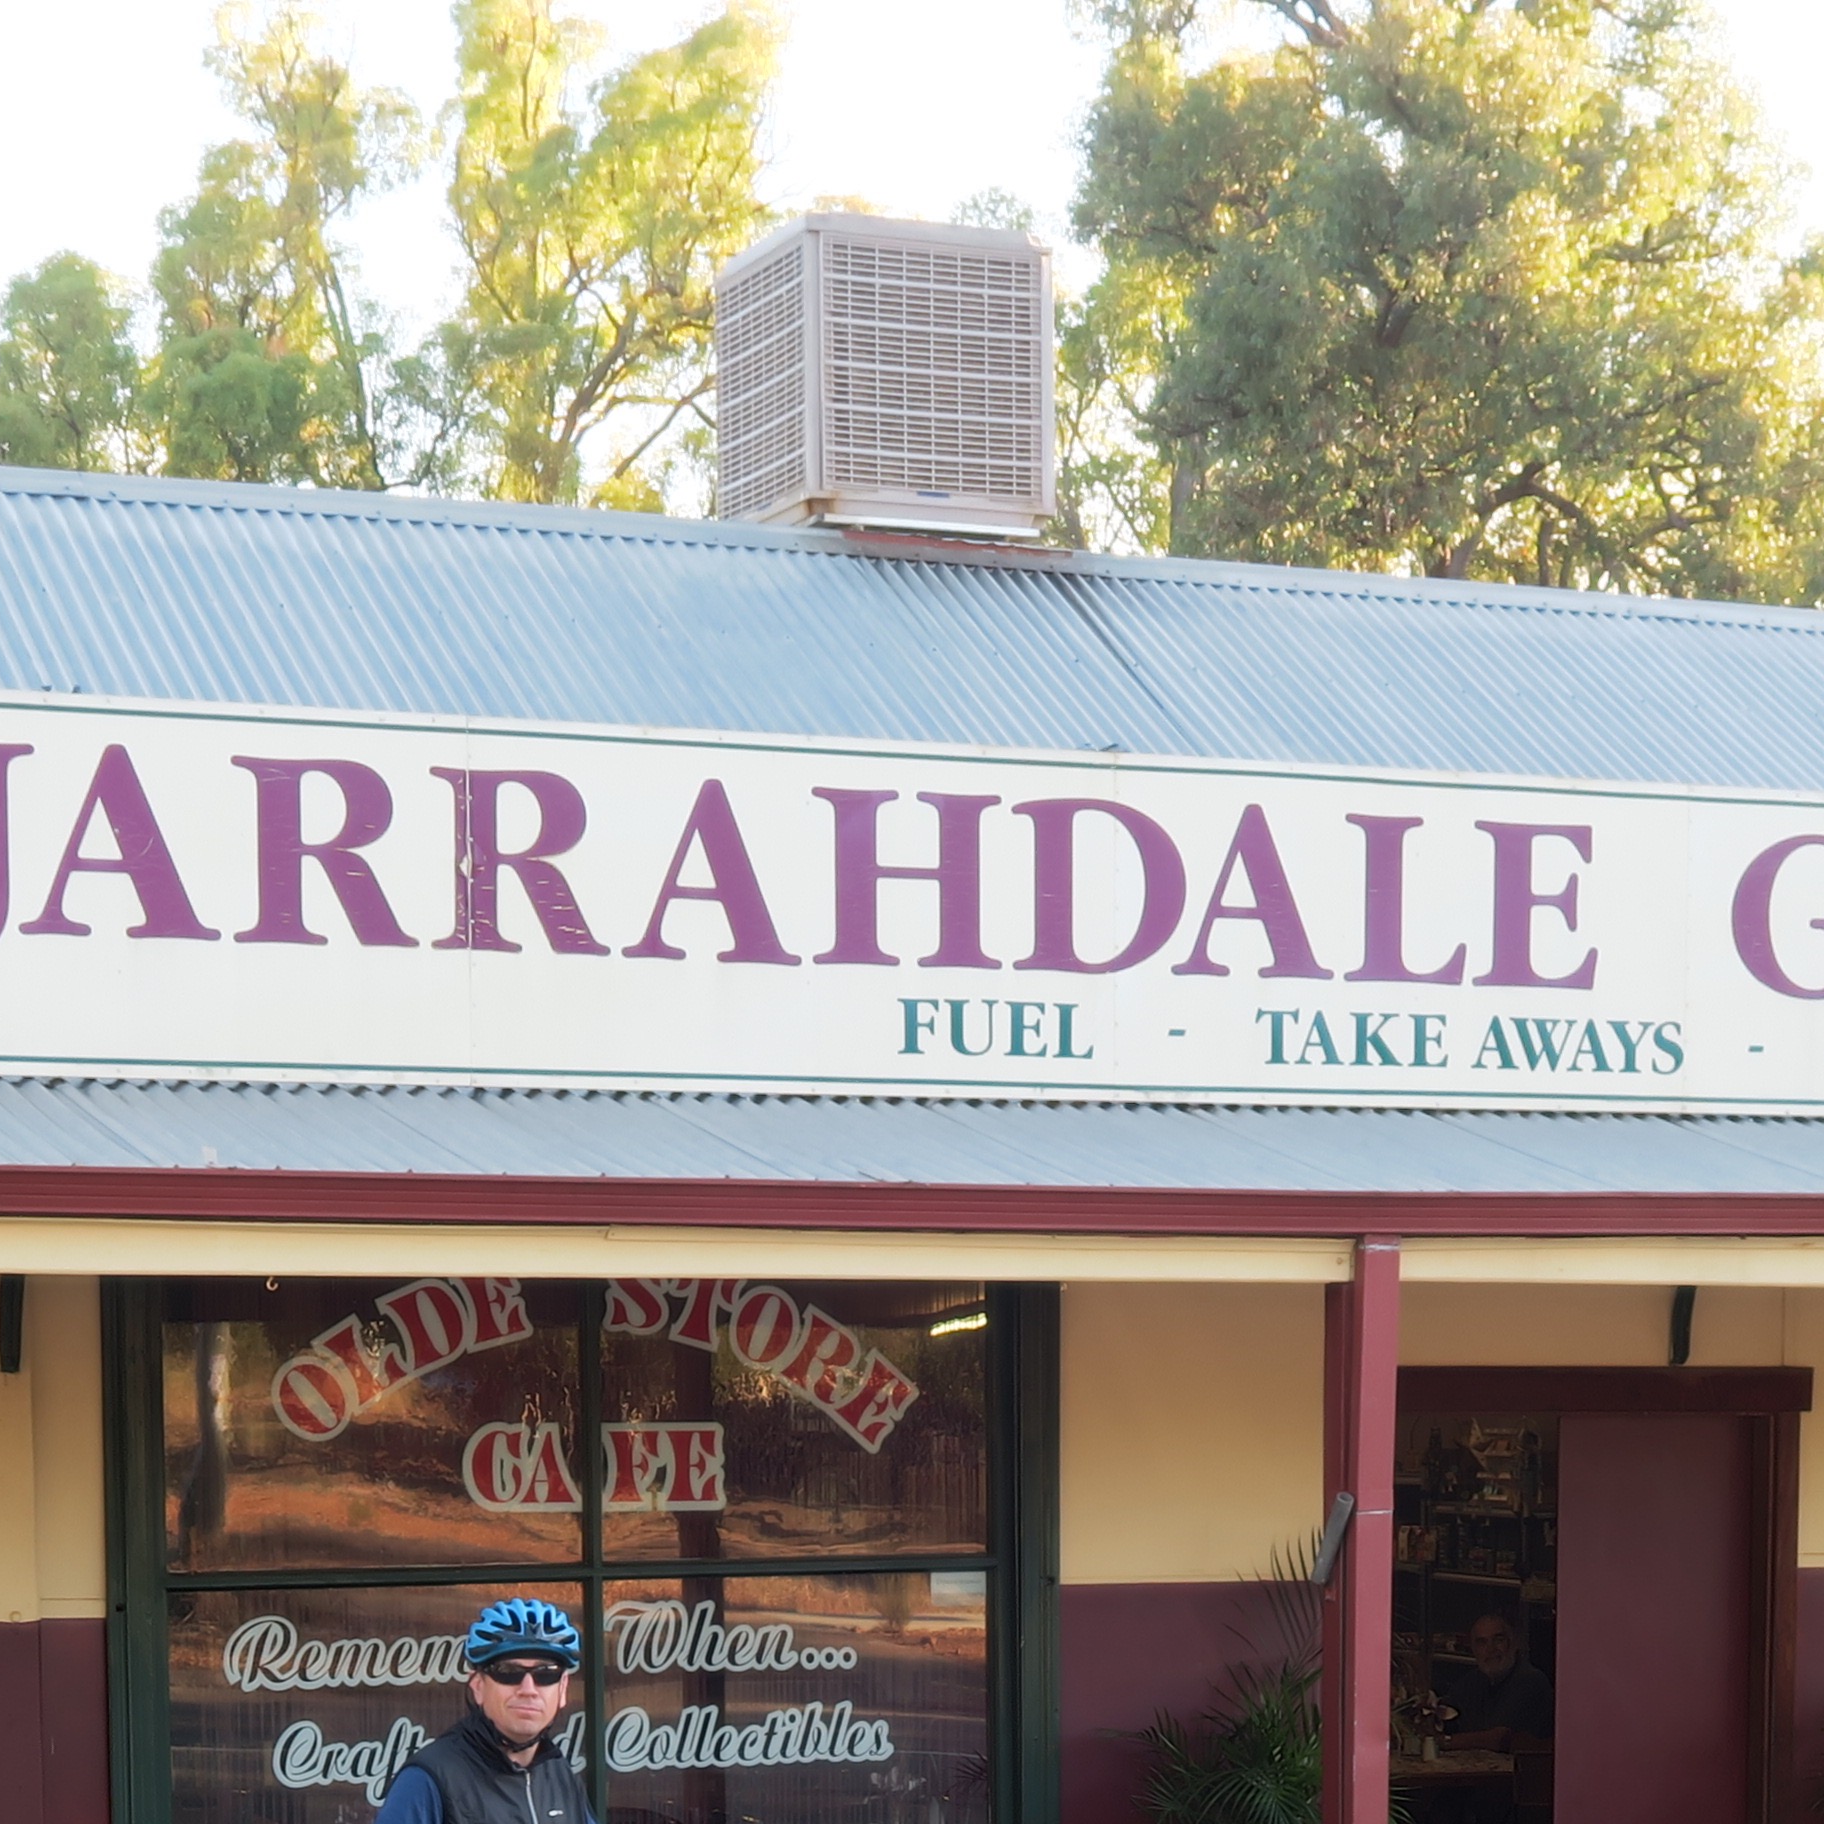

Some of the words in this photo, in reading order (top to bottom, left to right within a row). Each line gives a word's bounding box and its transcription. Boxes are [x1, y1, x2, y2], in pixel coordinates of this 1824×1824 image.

[896, 997, 1094, 1060] FUEL
[1255, 1007, 1450, 1069] TAKE
[1470, 1015, 1685, 1076] AWAYS
[270, 1277, 534, 1442] OLDE
[602, 1278, 920, 1455] STORE
[462, 1421, 726, 1513] CAFE
[223, 1615, 579, 1692] Remem
[604, 1599, 858, 1674] When...
[272, 1716, 435, 1807] Craft
[604, 1700, 895, 1773] Collectibles
